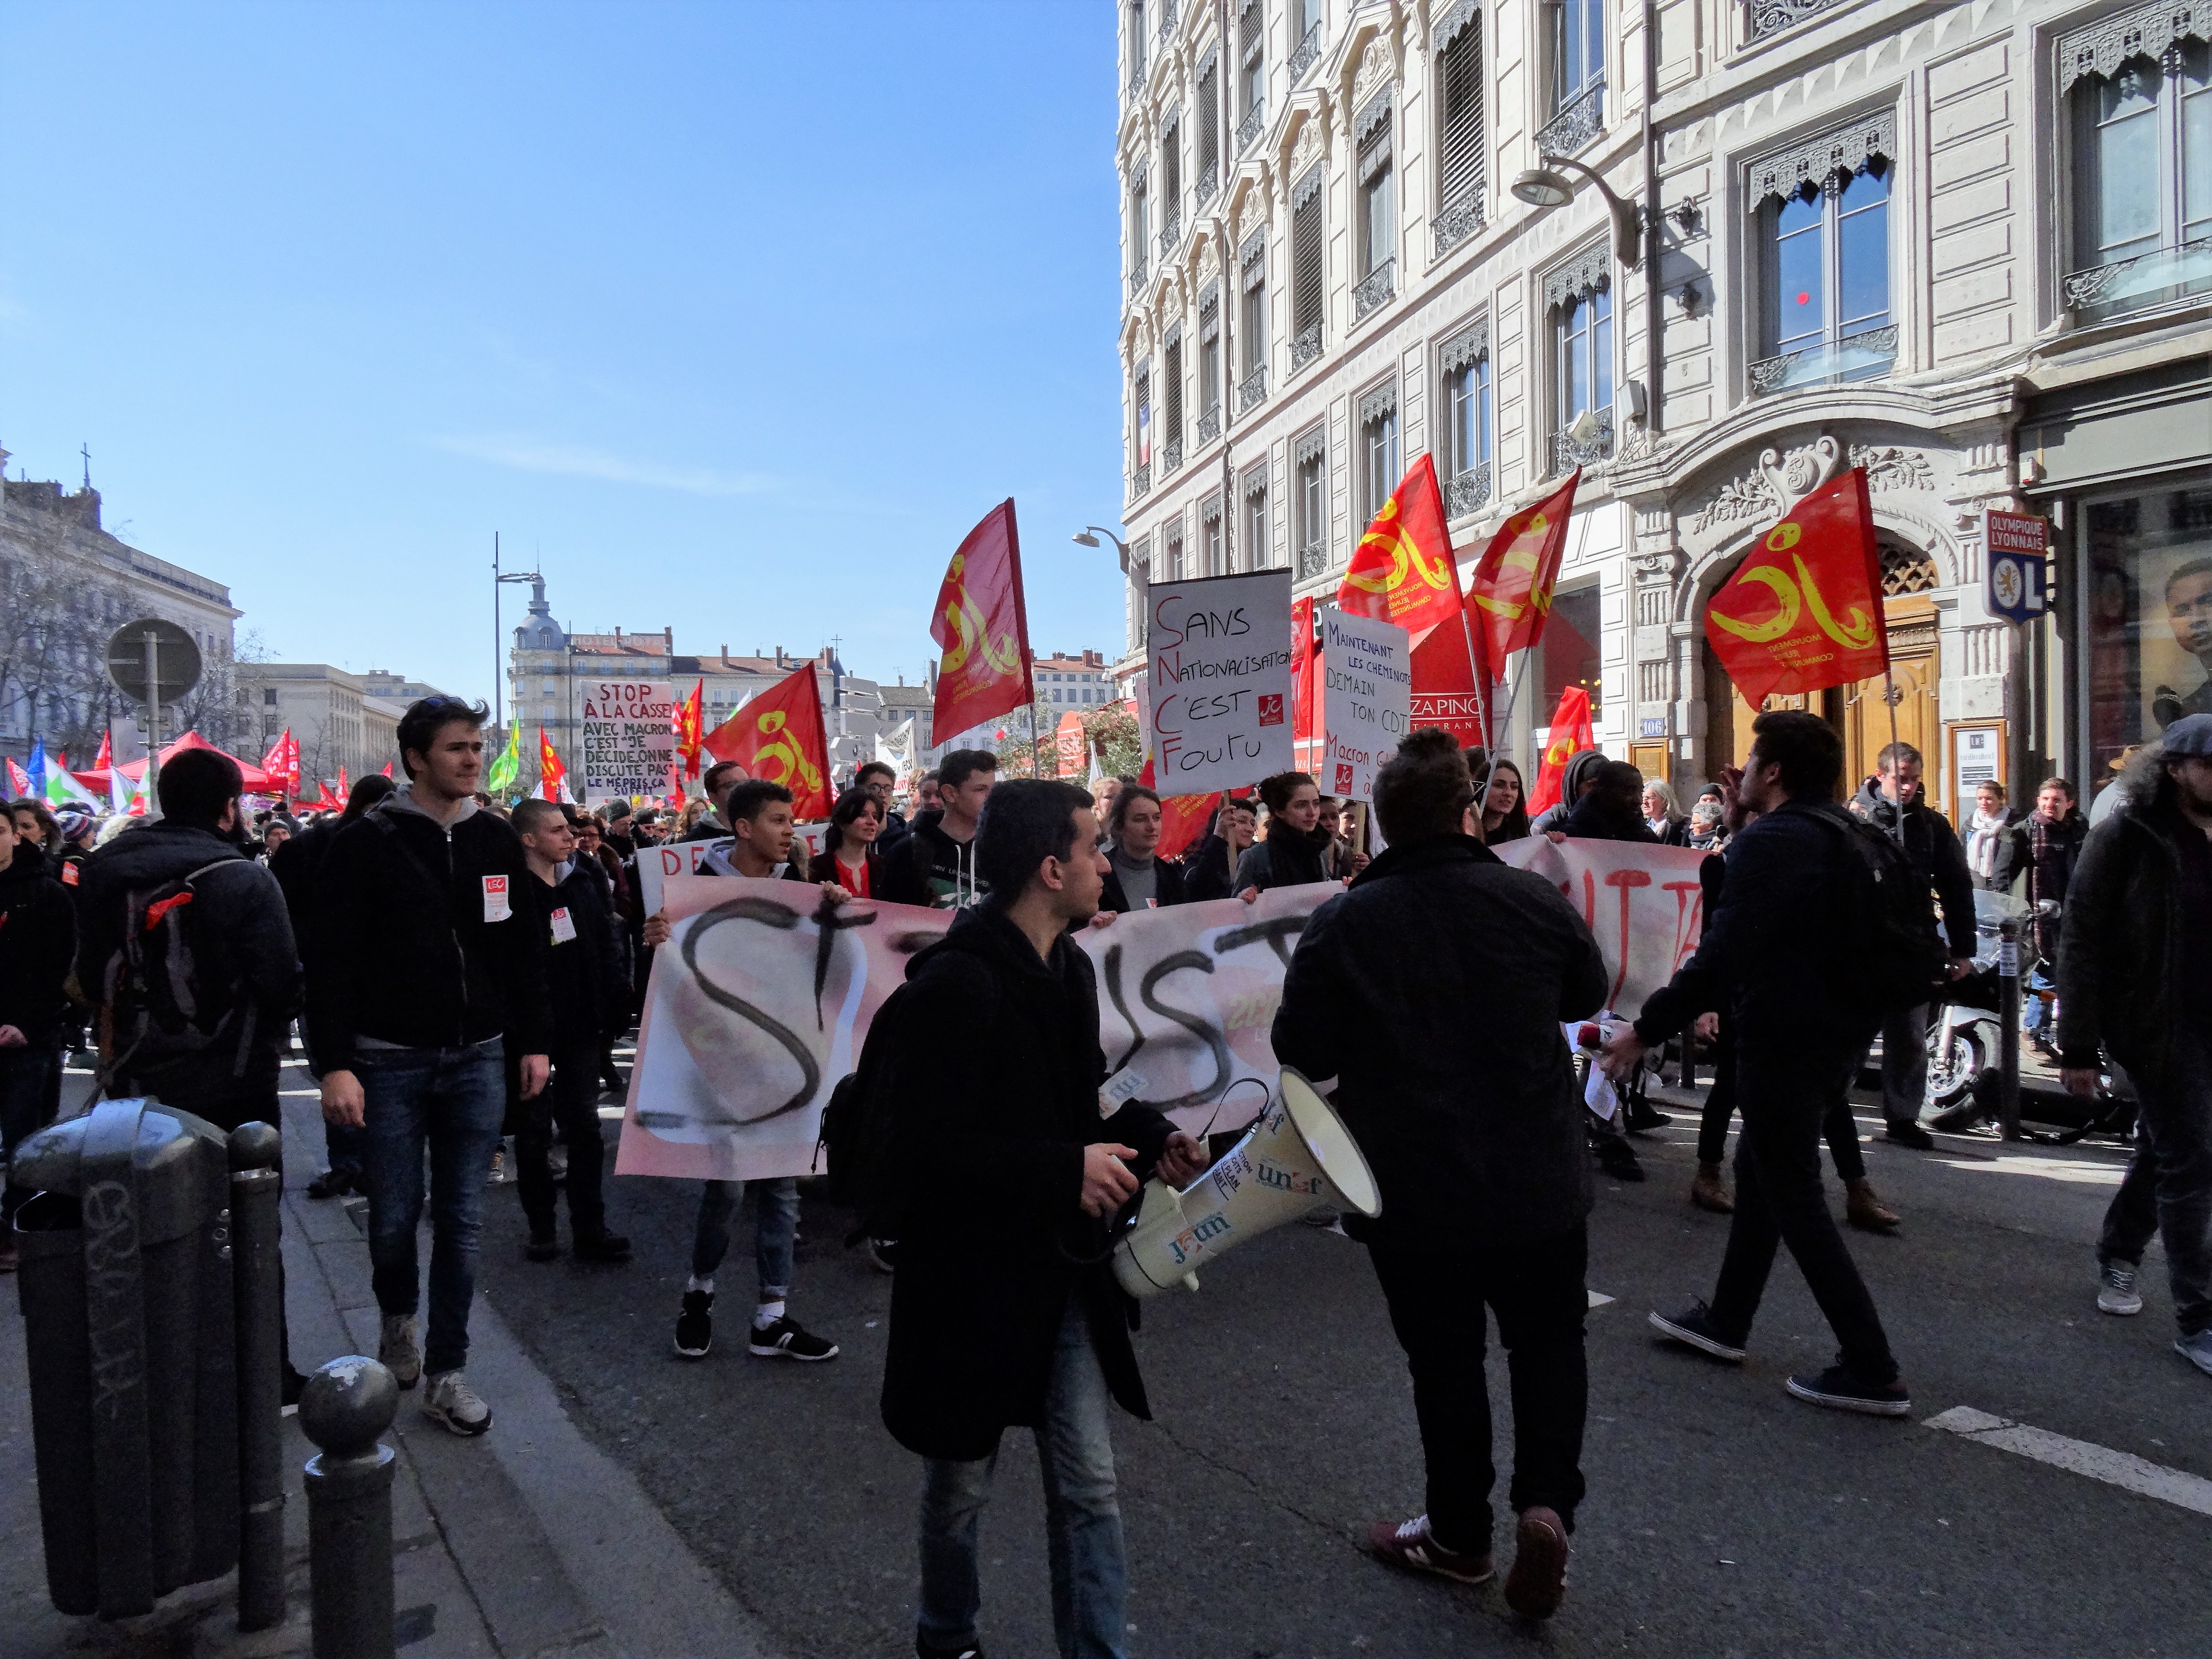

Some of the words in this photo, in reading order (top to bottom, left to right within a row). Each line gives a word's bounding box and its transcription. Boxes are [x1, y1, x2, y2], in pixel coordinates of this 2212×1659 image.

[1991, 516, 2043, 536] OLYMPIQUE
[1991, 532, 2043, 551] LYONNAIS
[1993, 558, 2044, 611] OL
[1156, 596, 1250, 651] SANS
[1328, 620, 1394, 659] MAINTENANT
[1348, 656, 1363, 669] LES
[1367, 661, 1411, 686] CHEMINOTS
[1327, 667, 1375, 697] DEMAIN
[600, 684, 652, 702] STOP
[585, 699, 598, 719] À
[602, 703, 625, 719] LA
[1155, 690, 1252, 734] C'EST
[1350, 701, 1375, 723] TON
[1382, 710, 1408, 737] CDI
[583, 722, 618, 736] AVEC
[624, 722, 673, 735] MACRON
[1643, 720, 1662, 735] 106
[585, 737, 618, 749] C'EST
[1326, 729, 1369, 765] Macron
[586, 764, 643, 777] DISCUTE
[588, 778, 602, 788] LE
